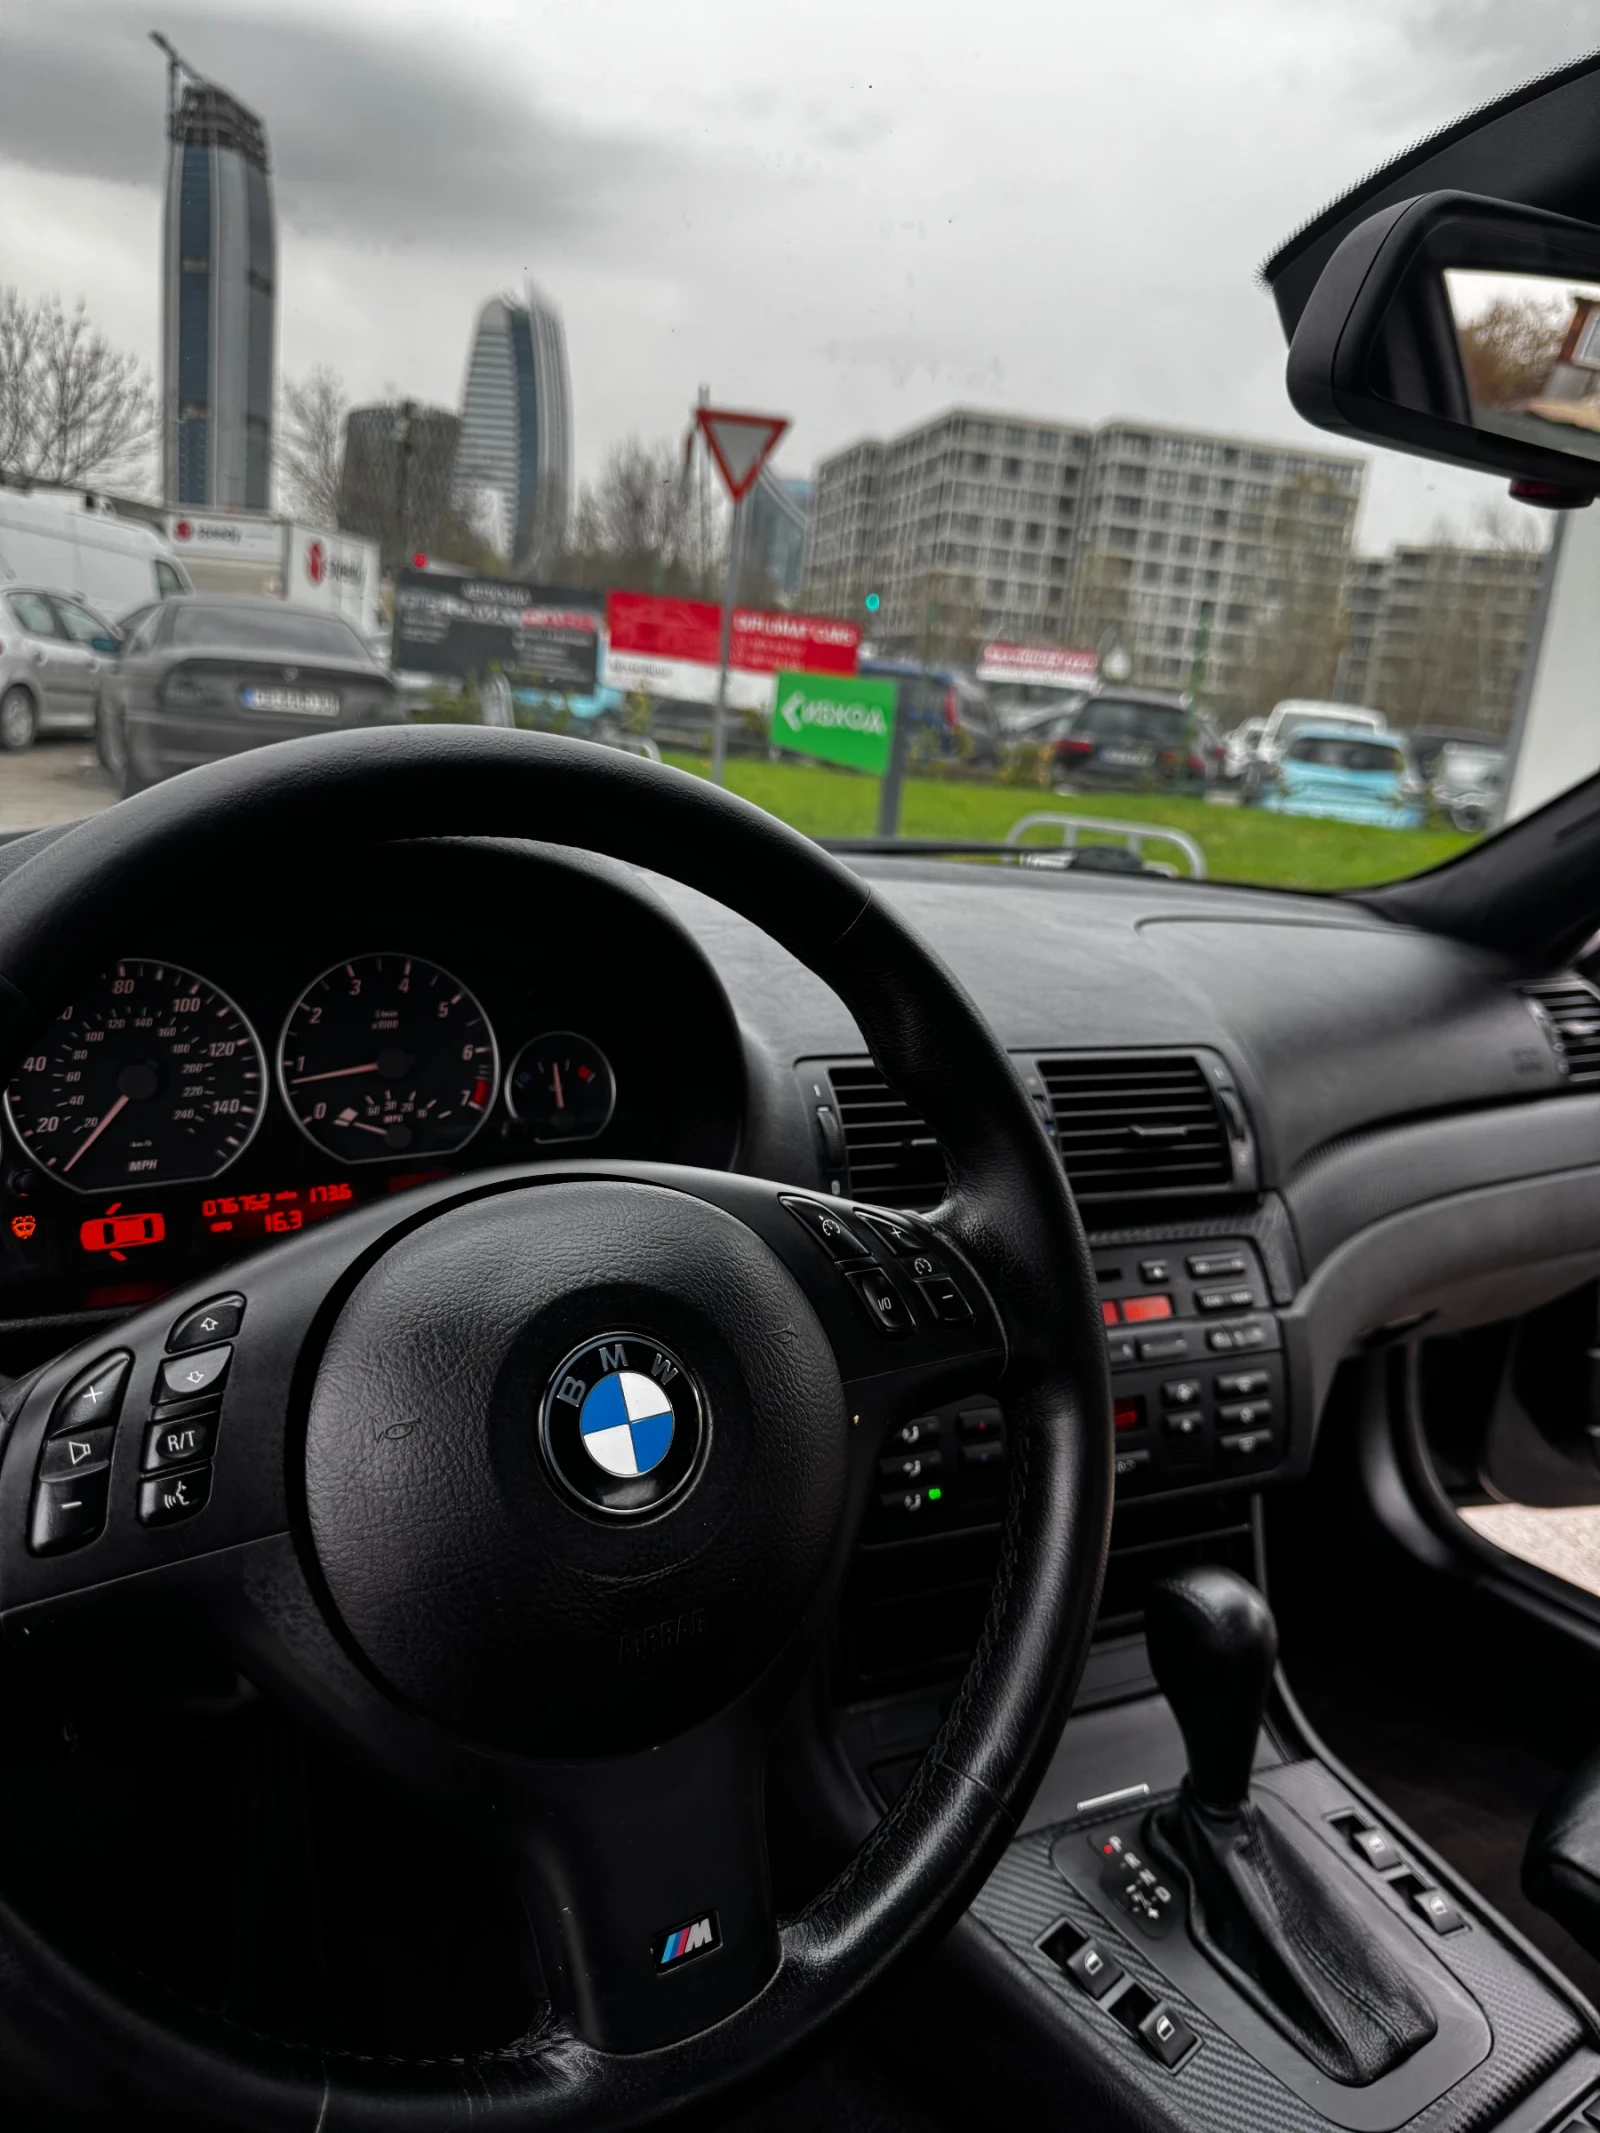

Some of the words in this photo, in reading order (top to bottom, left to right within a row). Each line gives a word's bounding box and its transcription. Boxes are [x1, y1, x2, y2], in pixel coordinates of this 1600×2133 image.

[112, 979, 135, 994] 80
[350, 978, 362, 996] 3
[398, 978, 409, 993] 4
[172, 997, 201, 1012] 100
[438, 1002, 449, 1018] 5
[135, 1017, 153, 1028] 140
[308, 1007, 322, 1024] 2
[108, 1018, 125, 1029] 120
[86, 1031, 104, 1042] 100
[158, 1026, 176, 1037] 160
[73, 1049, 88, 1060] 80
[208, 1041, 235, 1057] 120
[462, 1044, 473, 1060] 6
[23, 1056, 47, 1072] 40
[182, 1063, 203, 1074] 200
[297, 1056, 305, 1072] 1
[66, 1071, 81, 1082] 60
[182, 1086, 204, 1097] 220
[460, 1091, 470, 1106] 7
[69, 1094, 85, 1106] 40
[212, 1099, 241, 1115] 140
[384, 1101, 398, 1111] 30
[172, 1108, 195, 1120] 240
[314, 1102, 327, 1119] 0
[401, 1103, 414, 1113] 20
[36, 1116, 60, 1133] 20
[83, 1116, 98, 1128] 20
[129, 1159, 158, 1172] MPH
[556, 1343, 679, 1408] BMW
[167, 1430, 196, 1452] R/T
[684, 1917, 713, 1954] M
